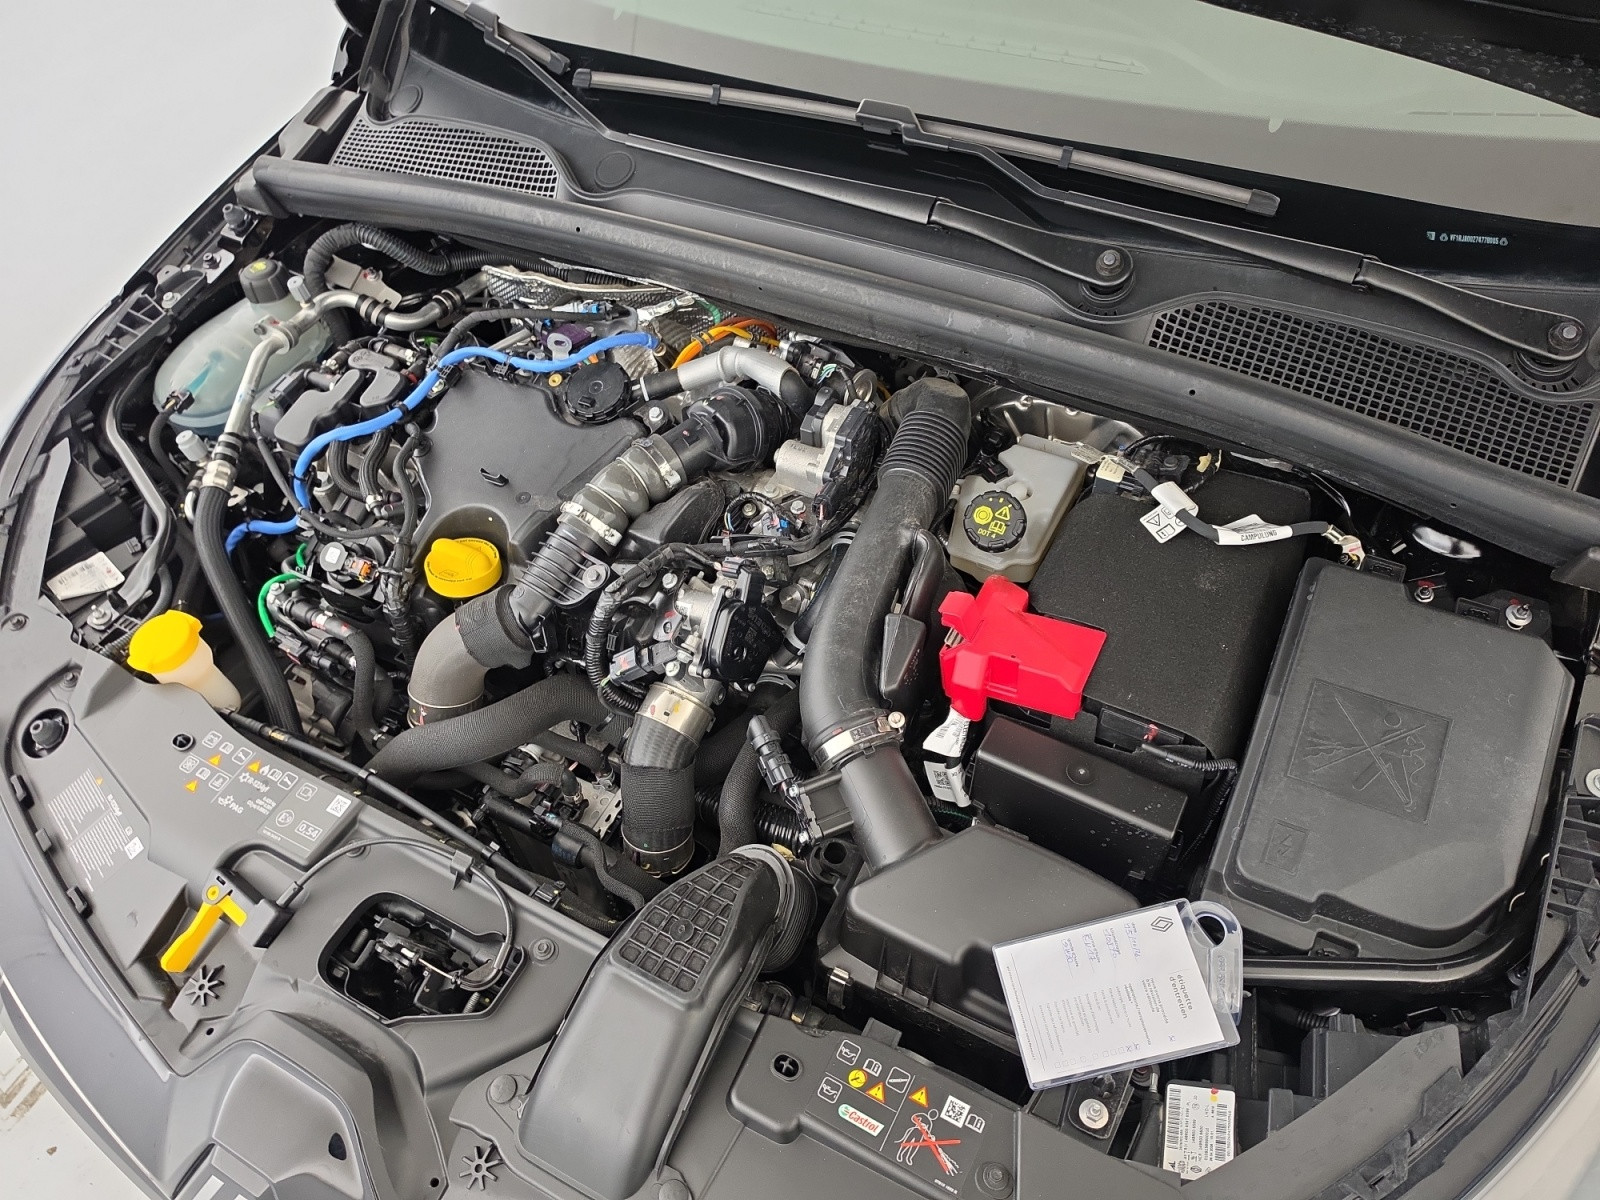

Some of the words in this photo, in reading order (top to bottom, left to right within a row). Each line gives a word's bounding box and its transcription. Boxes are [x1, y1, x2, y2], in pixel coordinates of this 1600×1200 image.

[977, 528, 991, 537] DOT
[1240, 528, 1277, 542] CAMPULUNG
[229, 803, 244, 815] PAG
[299, 823, 319, 838] 0,54
[1169, 977, 1187, 1018] d'entretien
[1176, 974, 1192, 1010] étiquette
[849, 1111, 879, 1132] Castrol
